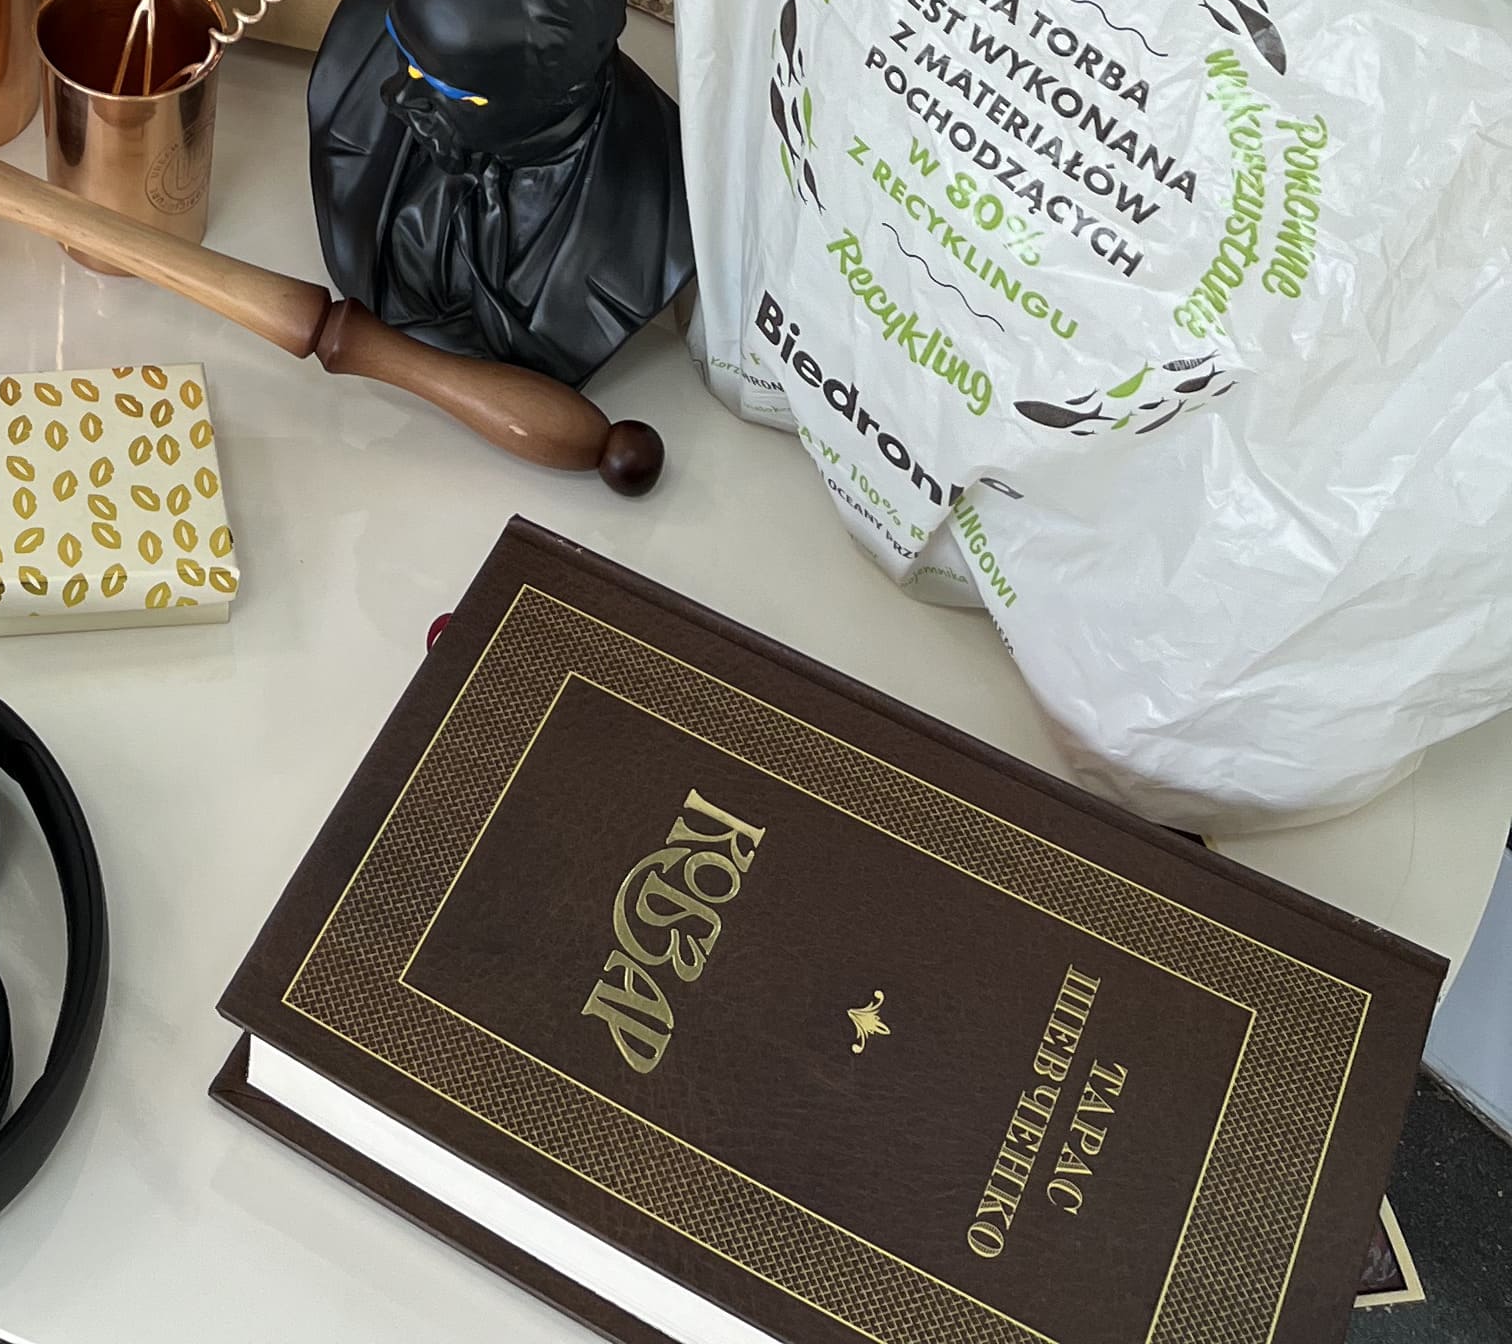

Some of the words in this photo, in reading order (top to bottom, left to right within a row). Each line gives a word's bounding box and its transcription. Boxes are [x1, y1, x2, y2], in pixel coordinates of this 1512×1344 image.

[890, 19, 916, 52] Z
[915, 44, 1160, 224] MATERIAŁÓW
[969, 24, 1197, 203] WYKONANA
[1029, 9, 1150, 113] TORBA
[847, 135, 870, 166] Z
[872, 158, 1079, 339] RECYKLINGU
[864, 46, 1144, 278] POCHODZĄCYCH
[909, 136, 940, 178] W
[946, 172, 1044, 266] 80%
[826, 227, 992, 416] Recykling
[827, 478, 883, 530] OCEANY
[851, 464, 901, 526] 100%
[581, 788, 766, 1073] КОБЗАР
[967, 964, 1101, 1259] ШЕВЧЕНКО
[1046, 1059, 1129, 1216] ТАРАС
